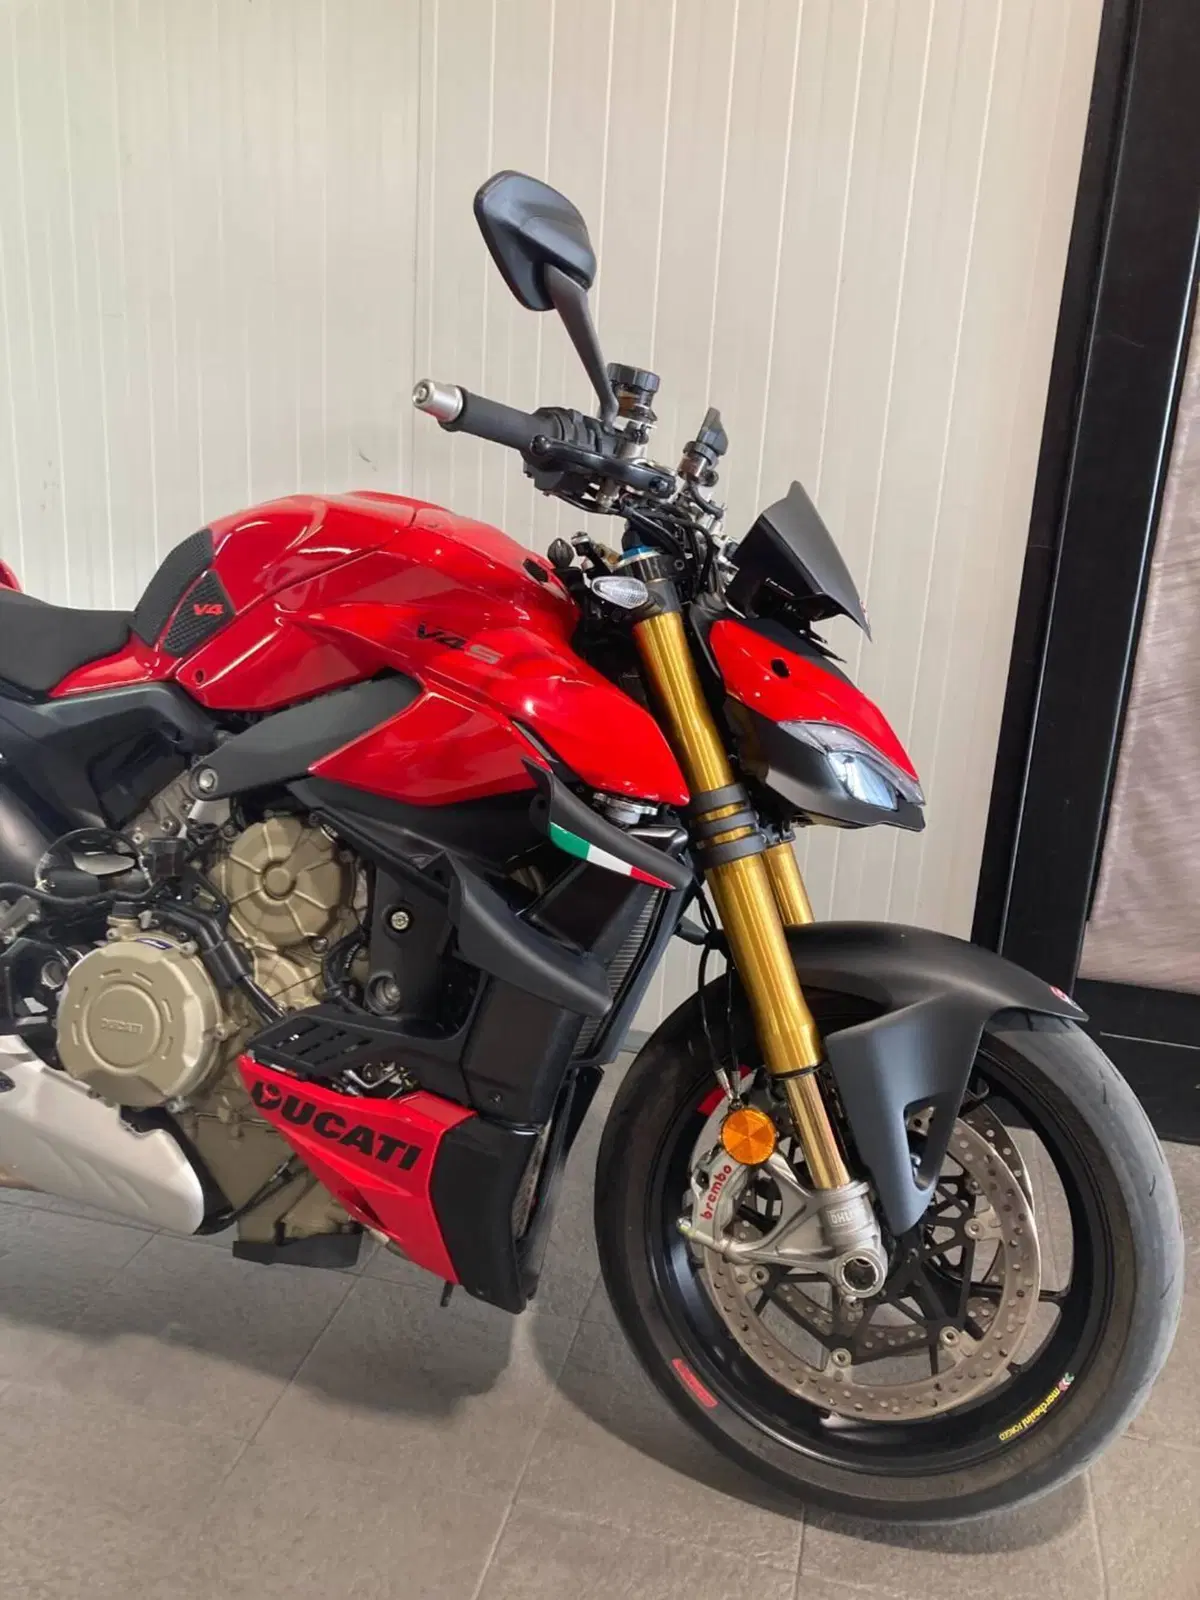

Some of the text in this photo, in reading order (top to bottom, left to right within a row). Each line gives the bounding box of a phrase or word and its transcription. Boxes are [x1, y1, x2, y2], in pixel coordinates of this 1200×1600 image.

[193, 603, 224, 616] V4
[251, 1080, 423, 1171] DUCATI
[700, 1165, 732, 1220] brembo
[1021, 1387, 1060, 1428] marchesini
